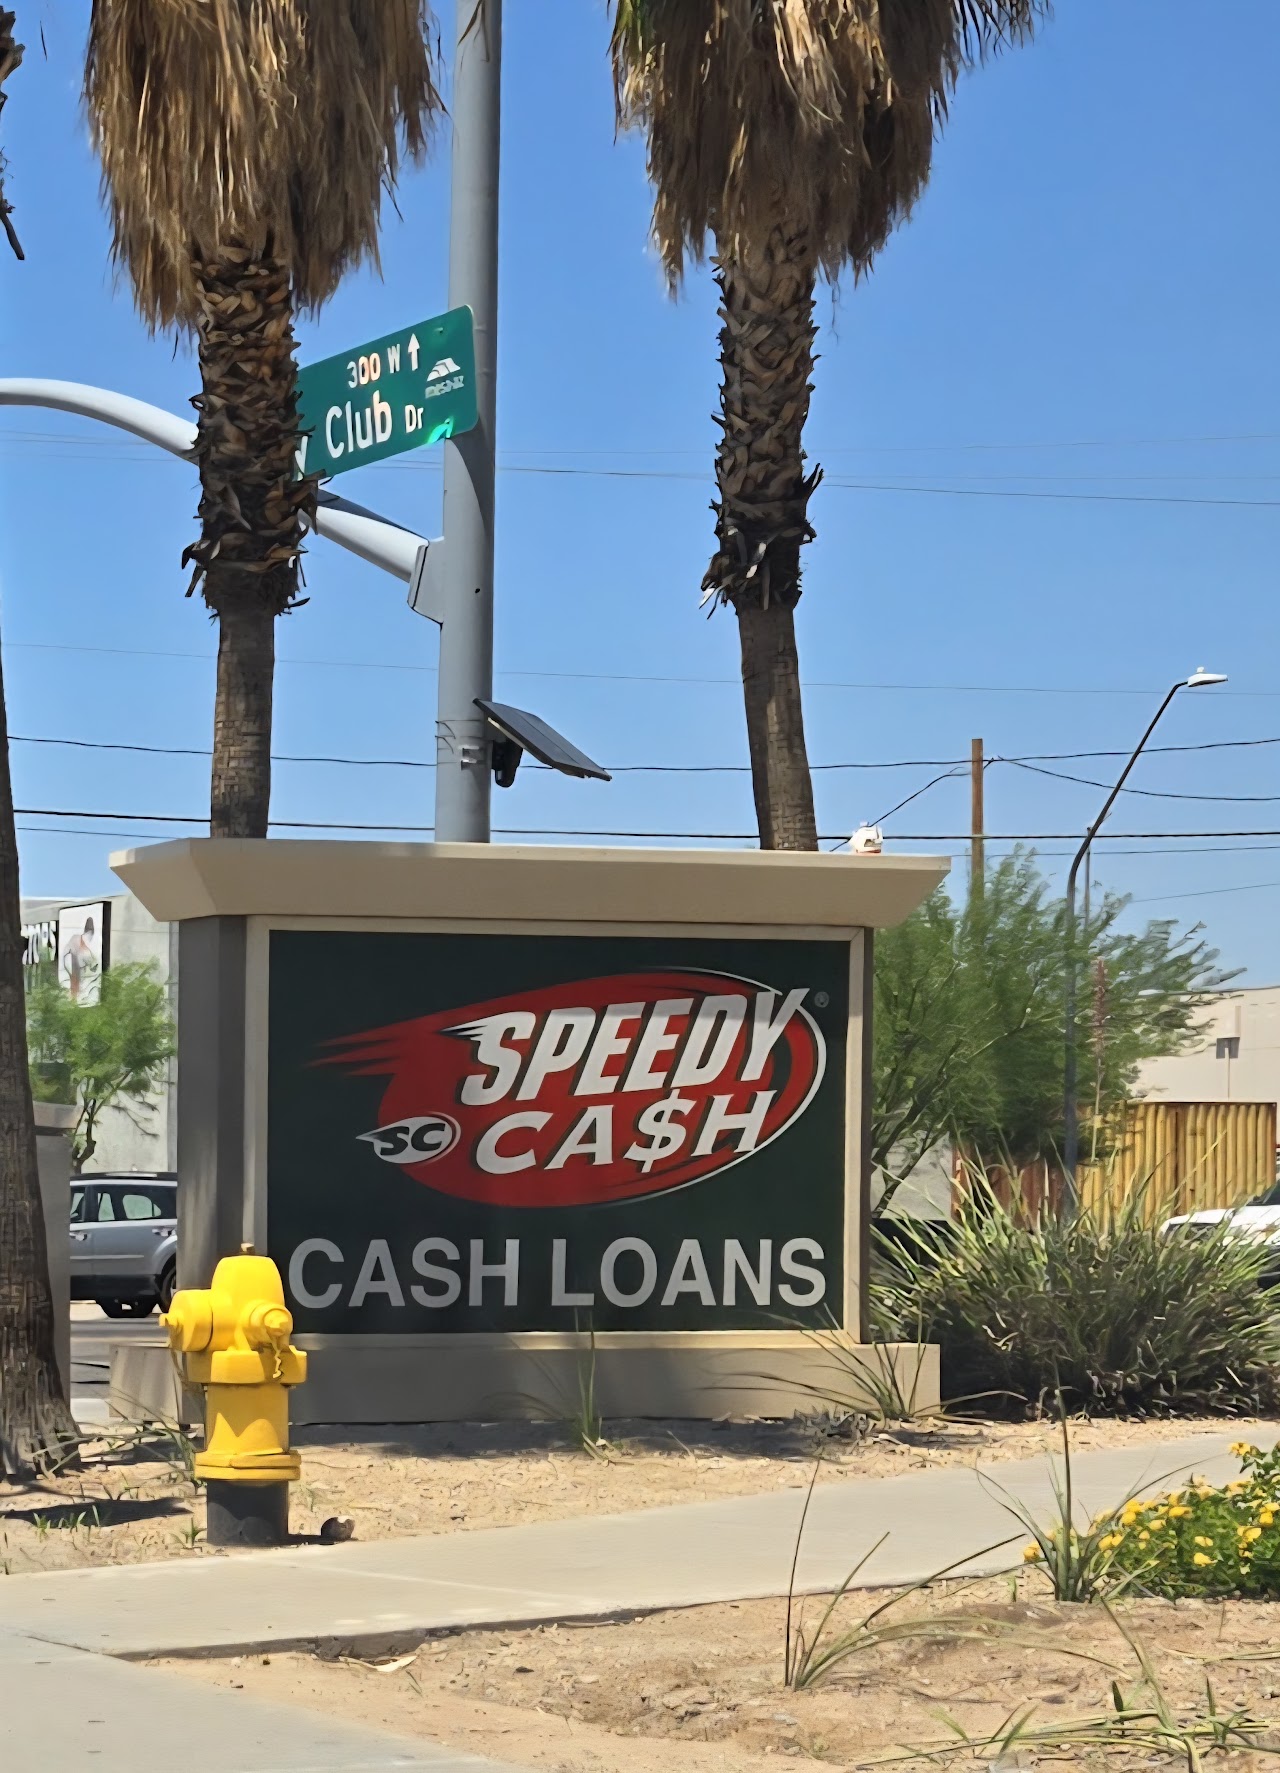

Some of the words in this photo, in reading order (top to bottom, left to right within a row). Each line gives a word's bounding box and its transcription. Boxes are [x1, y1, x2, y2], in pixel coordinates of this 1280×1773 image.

[346, 352, 381, 388] 300
[387, 343, 401, 374] W
[325, 390, 393, 458] Club
[404, 404, 424, 433] Dr
[441, 988, 810, 1106] SPEEDY
[379, 1122, 446, 1154] SC
[475, 1089, 778, 1174] CA$H
[288, 1238, 520, 1308] CASH
[551, 1236, 827, 1308] LOANS
